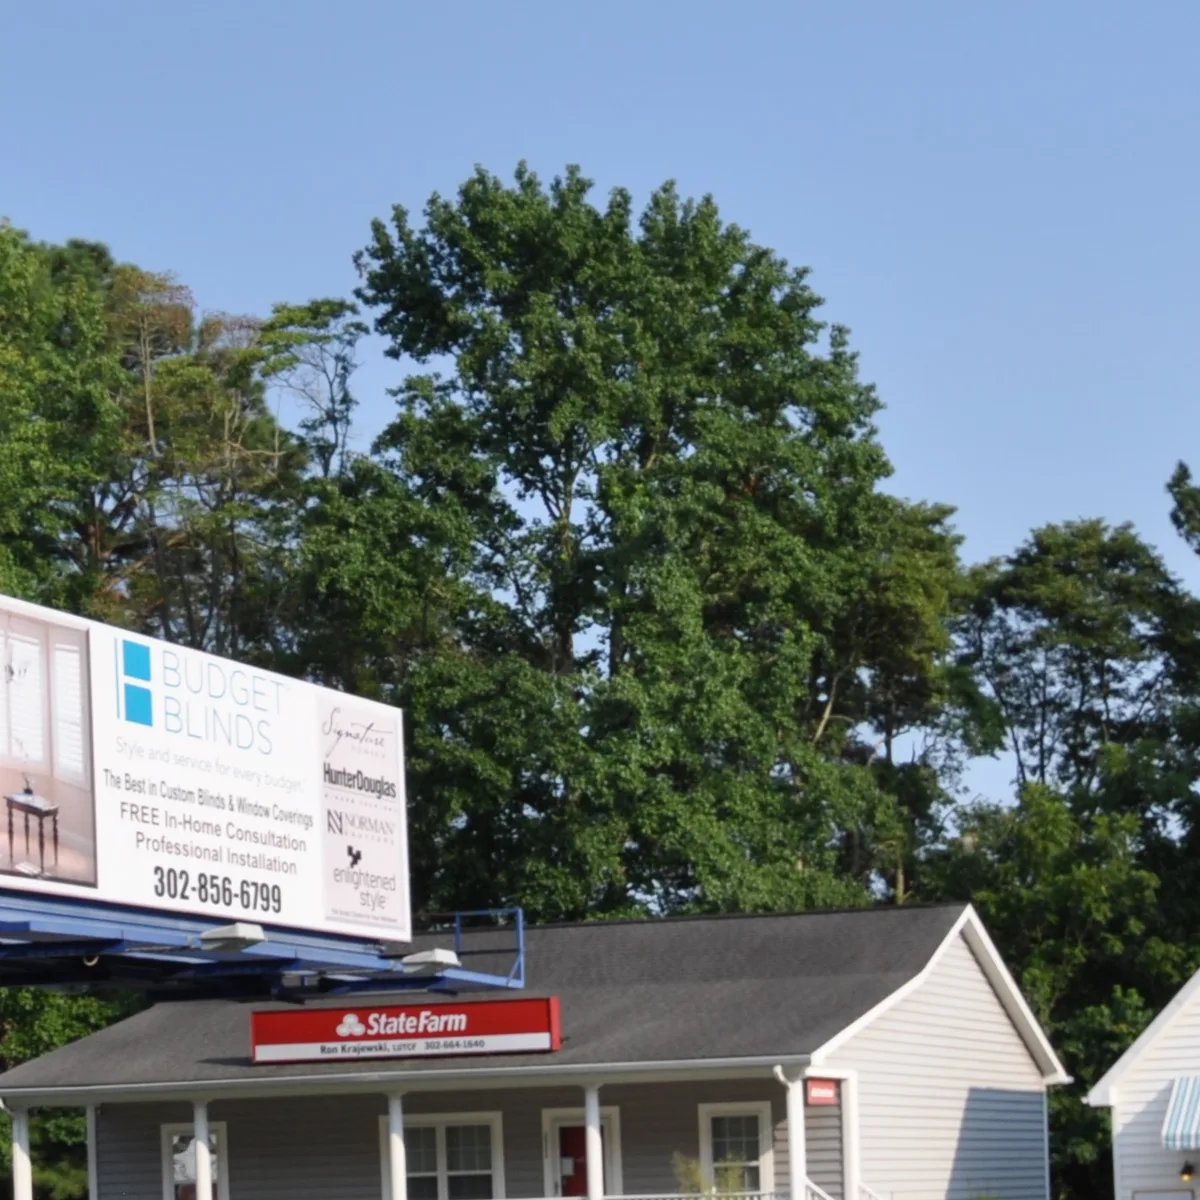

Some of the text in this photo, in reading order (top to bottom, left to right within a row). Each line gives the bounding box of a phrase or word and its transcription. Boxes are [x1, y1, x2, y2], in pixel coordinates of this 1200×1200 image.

[162, 649, 283, 715] BUDGET
[163, 695, 273, 756] BLINDS
[322, 707, 394, 758] Signature
[116, 736, 145, 761] Style
[148, 743, 171, 763] and
[174, 750, 213, 774] service
[215, 758, 232, 776] for
[233, 765, 262, 788] every
[103, 768, 314, 831] The Best in Custom Blinds & Window Coverings
[120, 802, 307, 852] FREE In-Home Consultation
[344, 813, 394, 837] NORMAN
[135, 831, 298, 875] Professional Installation
[153, 866, 283, 914] 302-856-6799
[333, 866, 396, 892] enlightened
[359, 890, 386, 913] style
[320, 1044, 338, 1055] Ron
